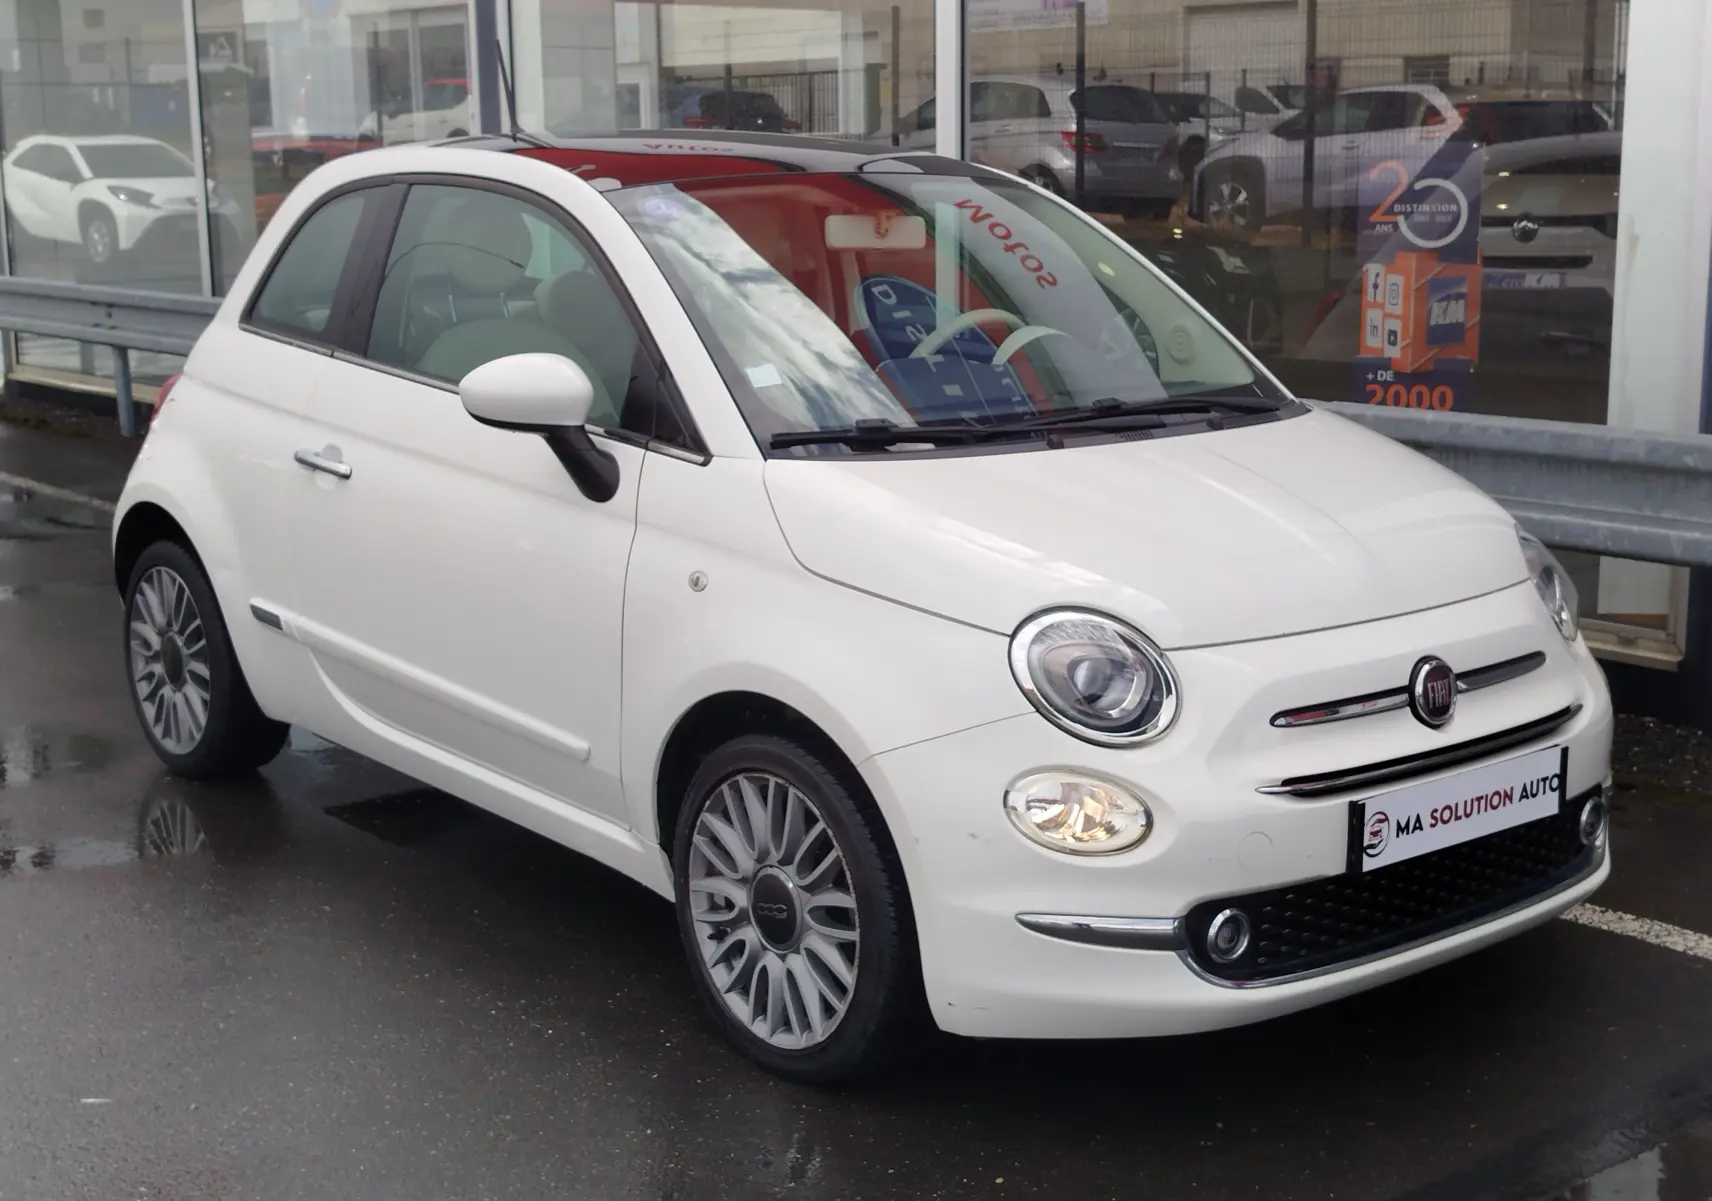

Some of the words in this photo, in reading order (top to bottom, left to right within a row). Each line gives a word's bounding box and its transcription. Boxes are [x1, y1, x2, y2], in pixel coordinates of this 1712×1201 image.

[1374, 223, 1394, 232] ANS
[1377, 370, 1395, 381] DE
[1365, 384, 1454, 411] 2000
[1427, 678, 1450, 709] FIAT
[1396, 812, 1424, 838] MA
[1429, 787, 1514, 828] SOLUTION
[1518, 772, 1562, 803] AUTO
